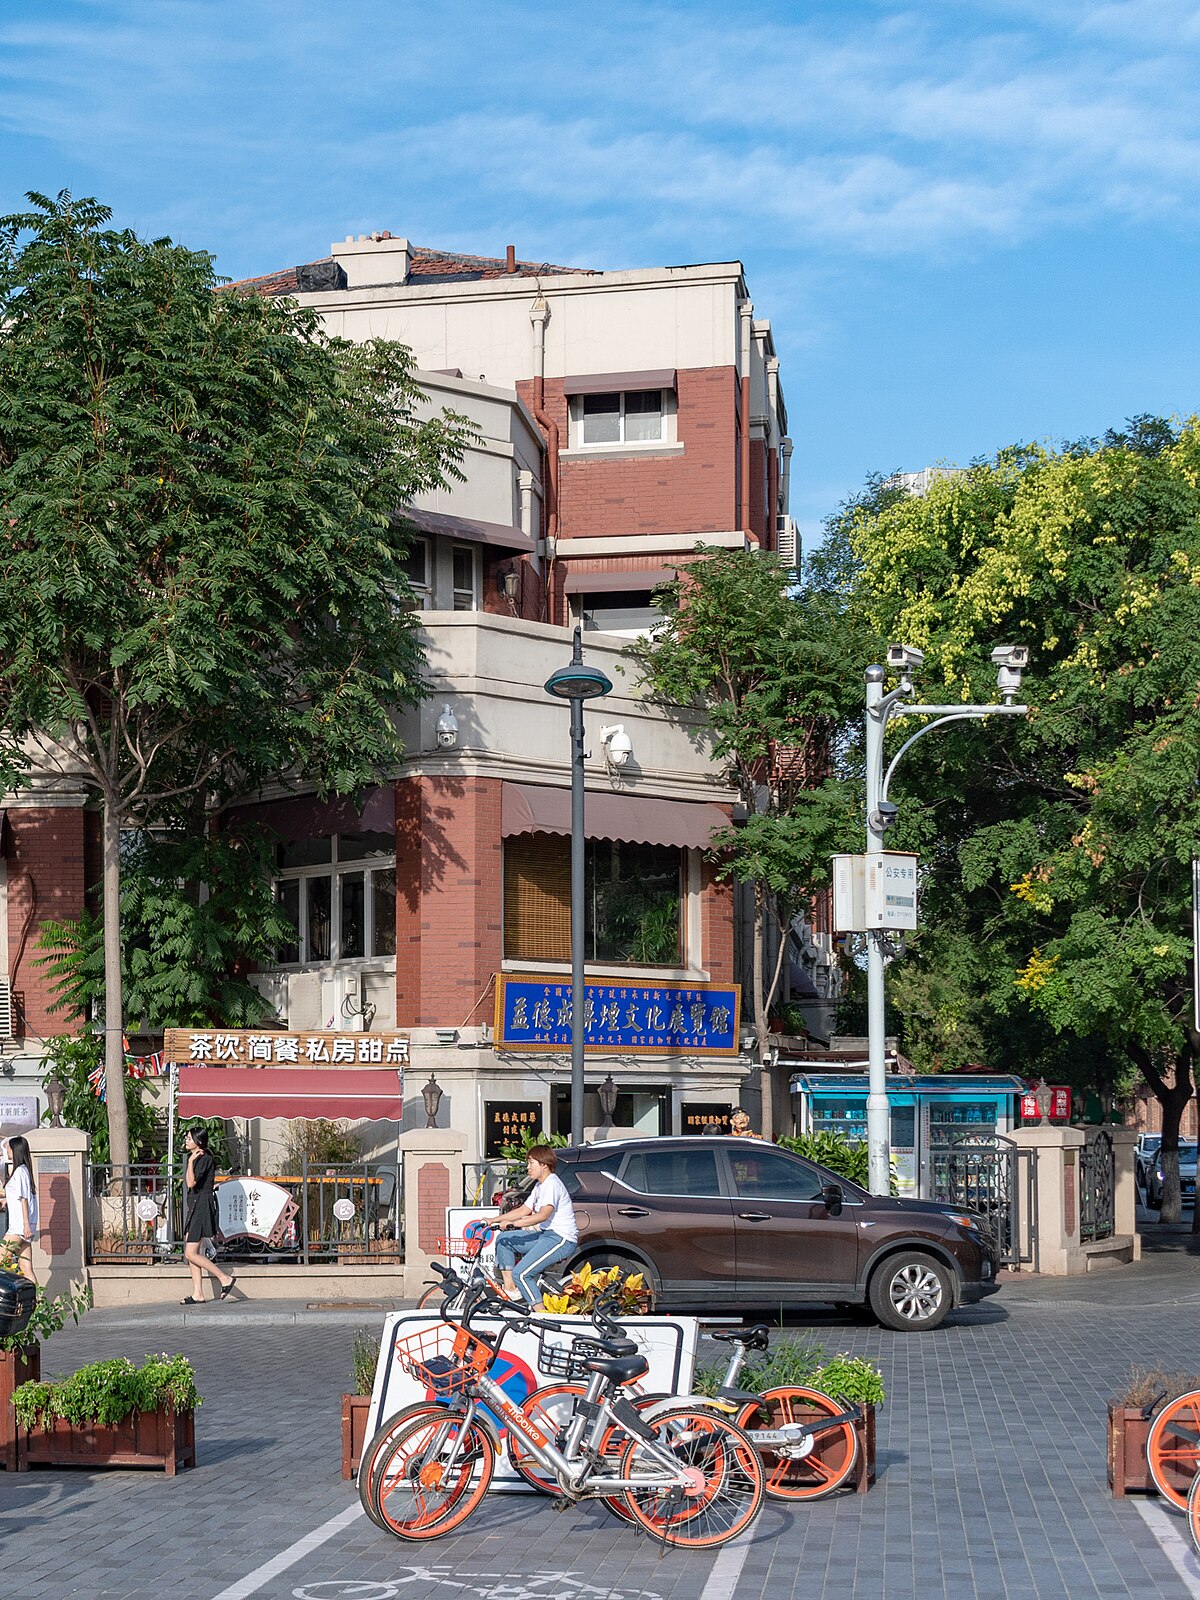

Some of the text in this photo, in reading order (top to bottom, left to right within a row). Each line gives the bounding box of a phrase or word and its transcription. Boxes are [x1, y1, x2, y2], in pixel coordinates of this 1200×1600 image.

[886, 867, 913, 879] 公安专用
[507, 1406, 540, 1441] mobike
